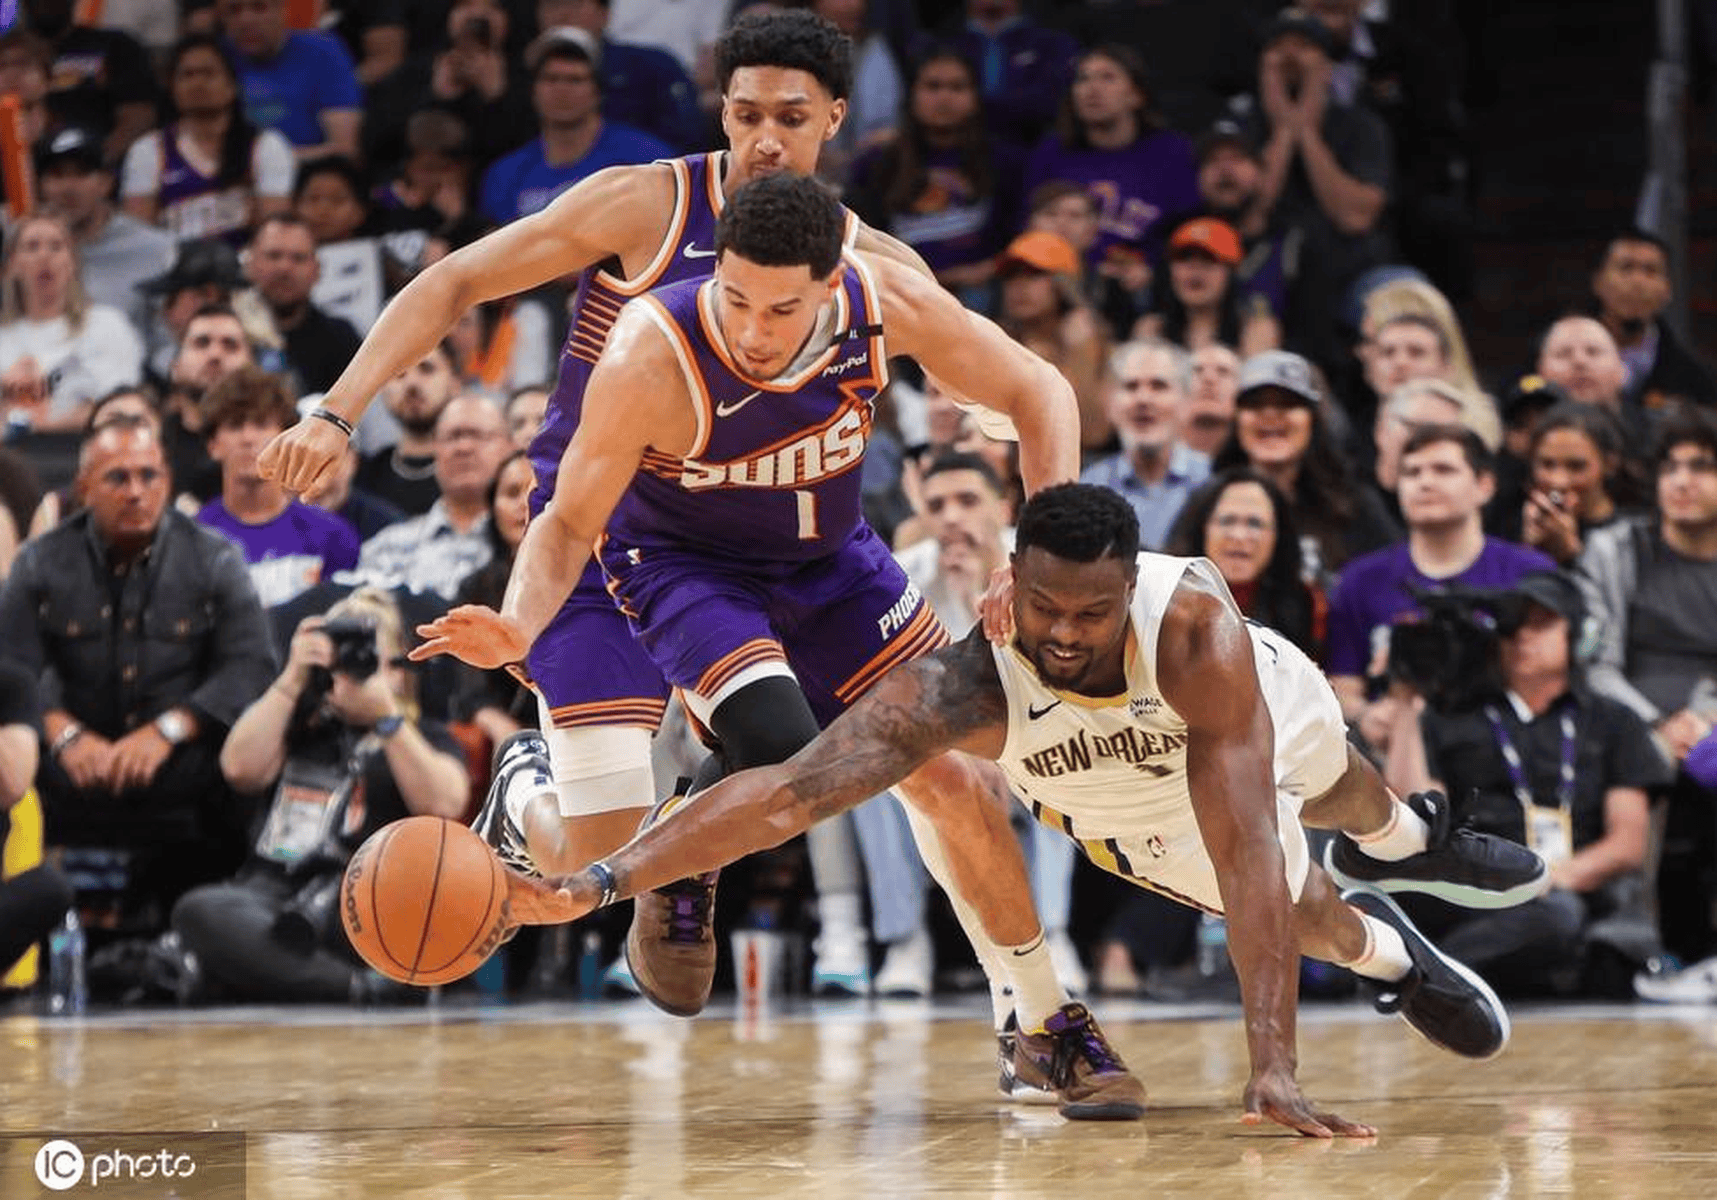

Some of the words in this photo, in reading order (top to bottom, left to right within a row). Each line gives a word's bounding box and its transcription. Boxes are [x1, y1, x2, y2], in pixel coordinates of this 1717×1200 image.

[821, 351, 868, 378] PayPal
[681, 407, 865, 489] SUNS
[796, 490, 821, 541] 1
[1021, 727, 1093, 777] NEW
[1091, 726, 1188, 764] ORLEA
